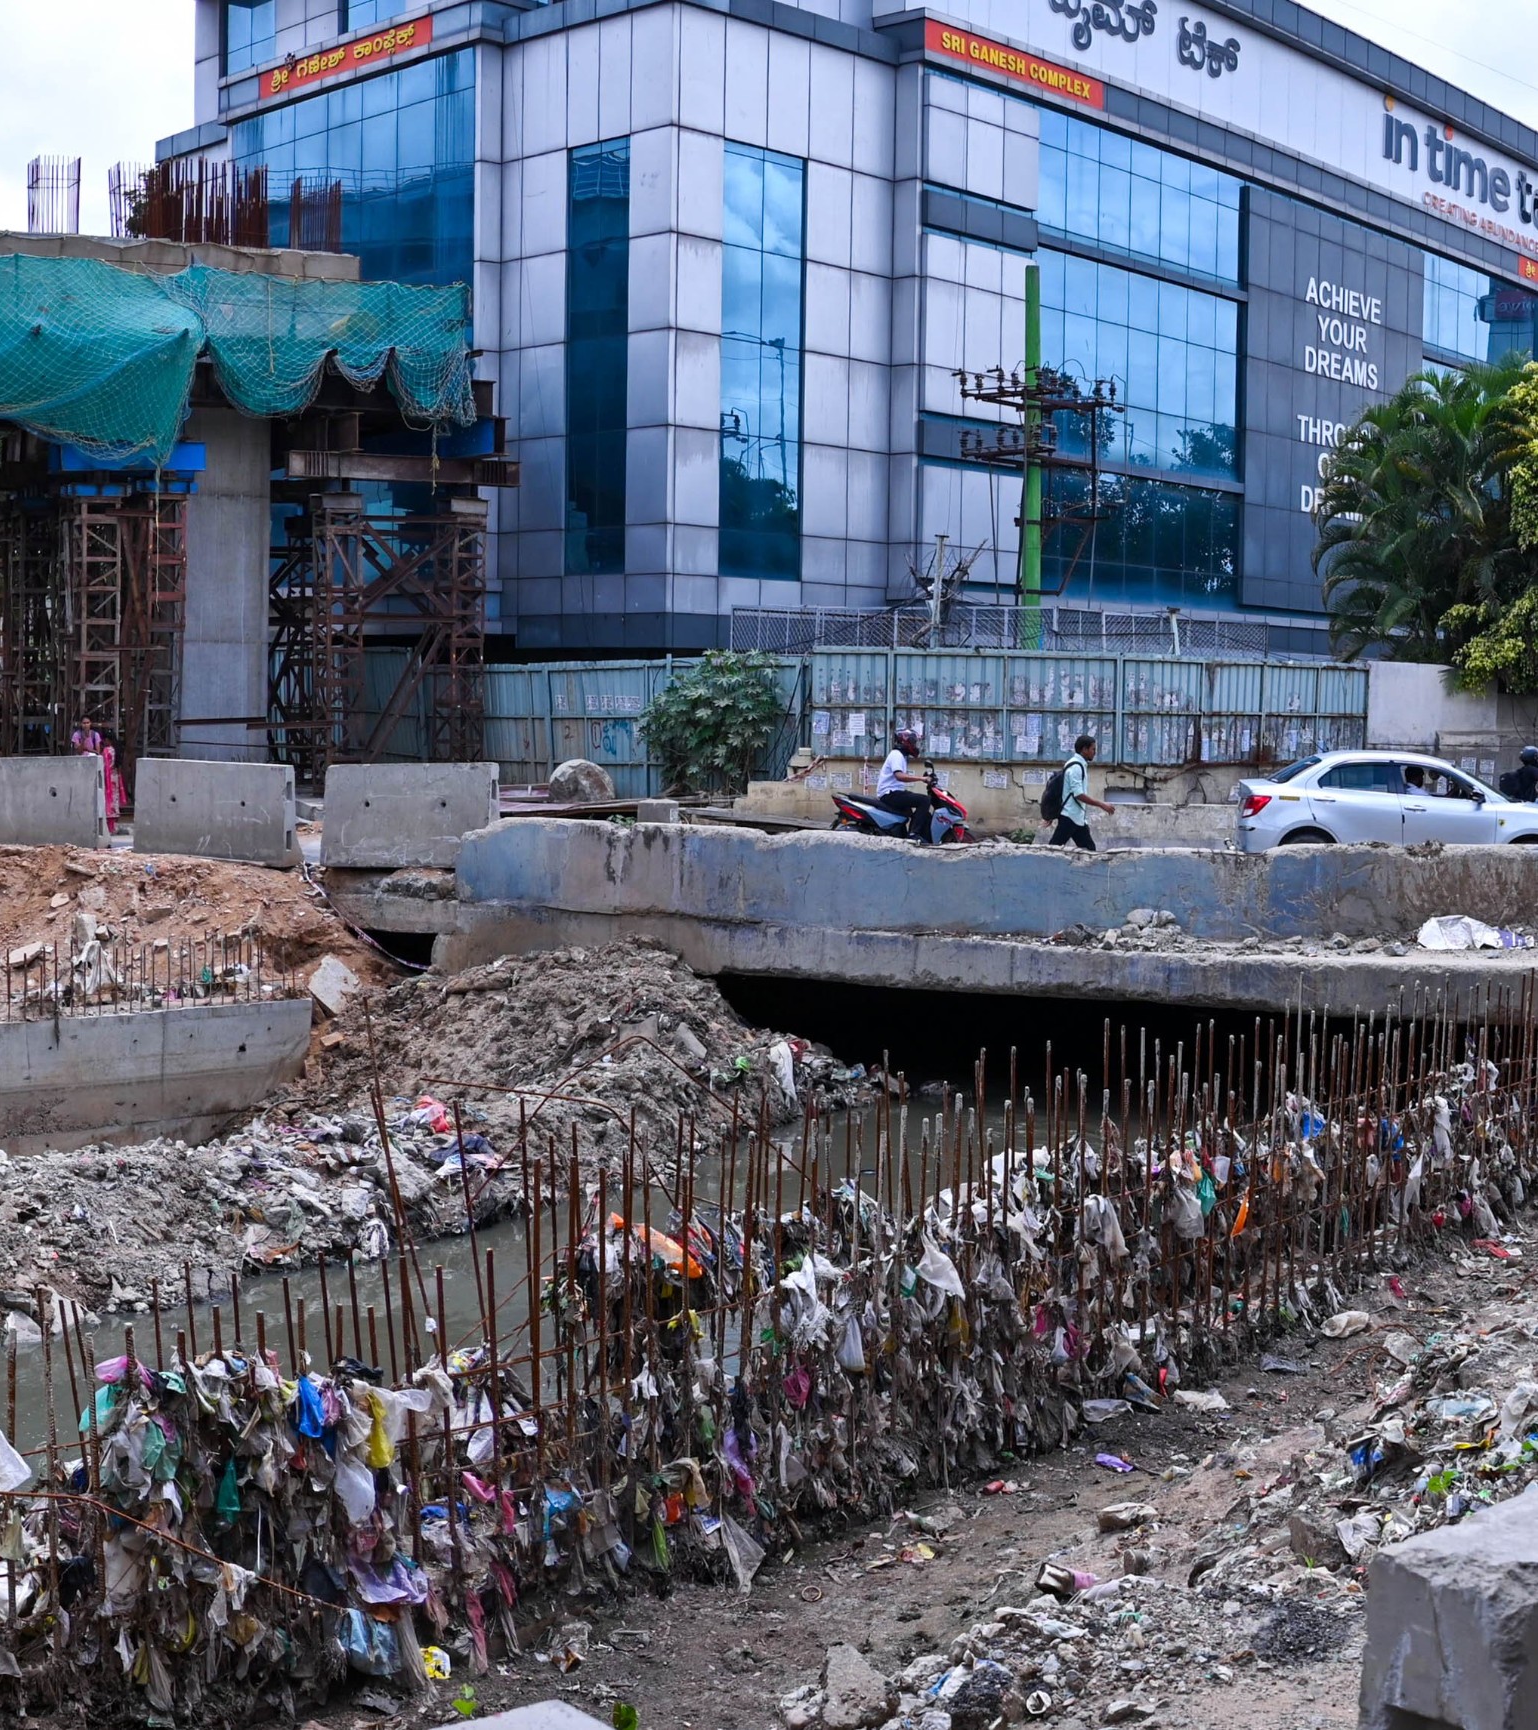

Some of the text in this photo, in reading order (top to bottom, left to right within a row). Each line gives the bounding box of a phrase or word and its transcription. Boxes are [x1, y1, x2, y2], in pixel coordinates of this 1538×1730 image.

[270, 69, 289, 93] ಶ್ರೀ
[296, 47, 346, 79] ಗಣೇಶ್
[941, 31, 1091, 100] SRI GANESH COMPLEX
[1176, 16, 1241, 78] ಟೆಕ್
[1383, 95, 1418, 172] in
[1424, 123, 1512, 213] time
[1422, 190, 1478, 227] CREATING
[1305, 276, 1382, 325] ACHIEVE
[1317, 314, 1368, 354] YOUR
[1304, 345, 1379, 391] DREAMS
[1296, 414, 1372, 451] THRO
